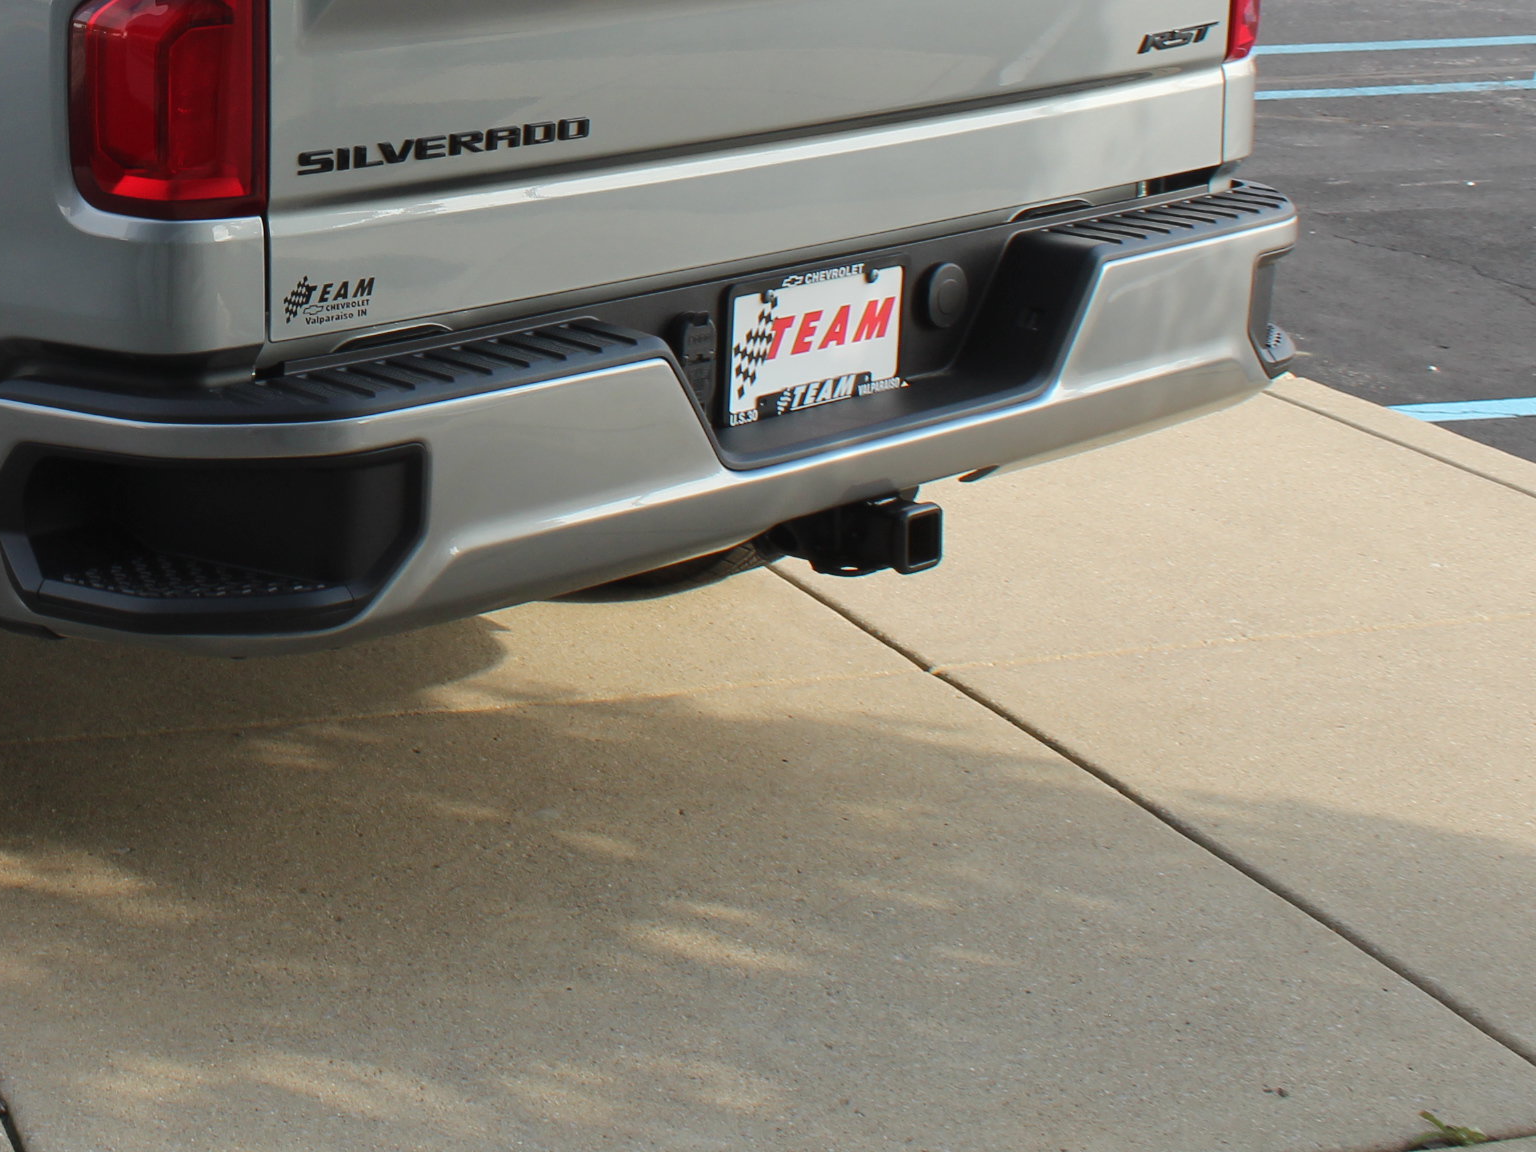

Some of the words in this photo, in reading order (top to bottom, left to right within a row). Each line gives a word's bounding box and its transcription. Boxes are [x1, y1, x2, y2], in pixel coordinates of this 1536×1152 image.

[1137, 21, 1220, 54] RST
[297, 117, 591, 176] SILVERADO
[805, 263, 866, 285] CHEVROLET
[304, 277, 375, 305] TEAM
[325, 299, 370, 312] CHEVROLET
[305, 312, 354, 325] Valparaiso
[357, 308, 367, 317] IN
[766, 296, 896, 361] TEAM
[790, 374, 857, 409] TEAM
[858, 377, 901, 396] VALPARAISO
